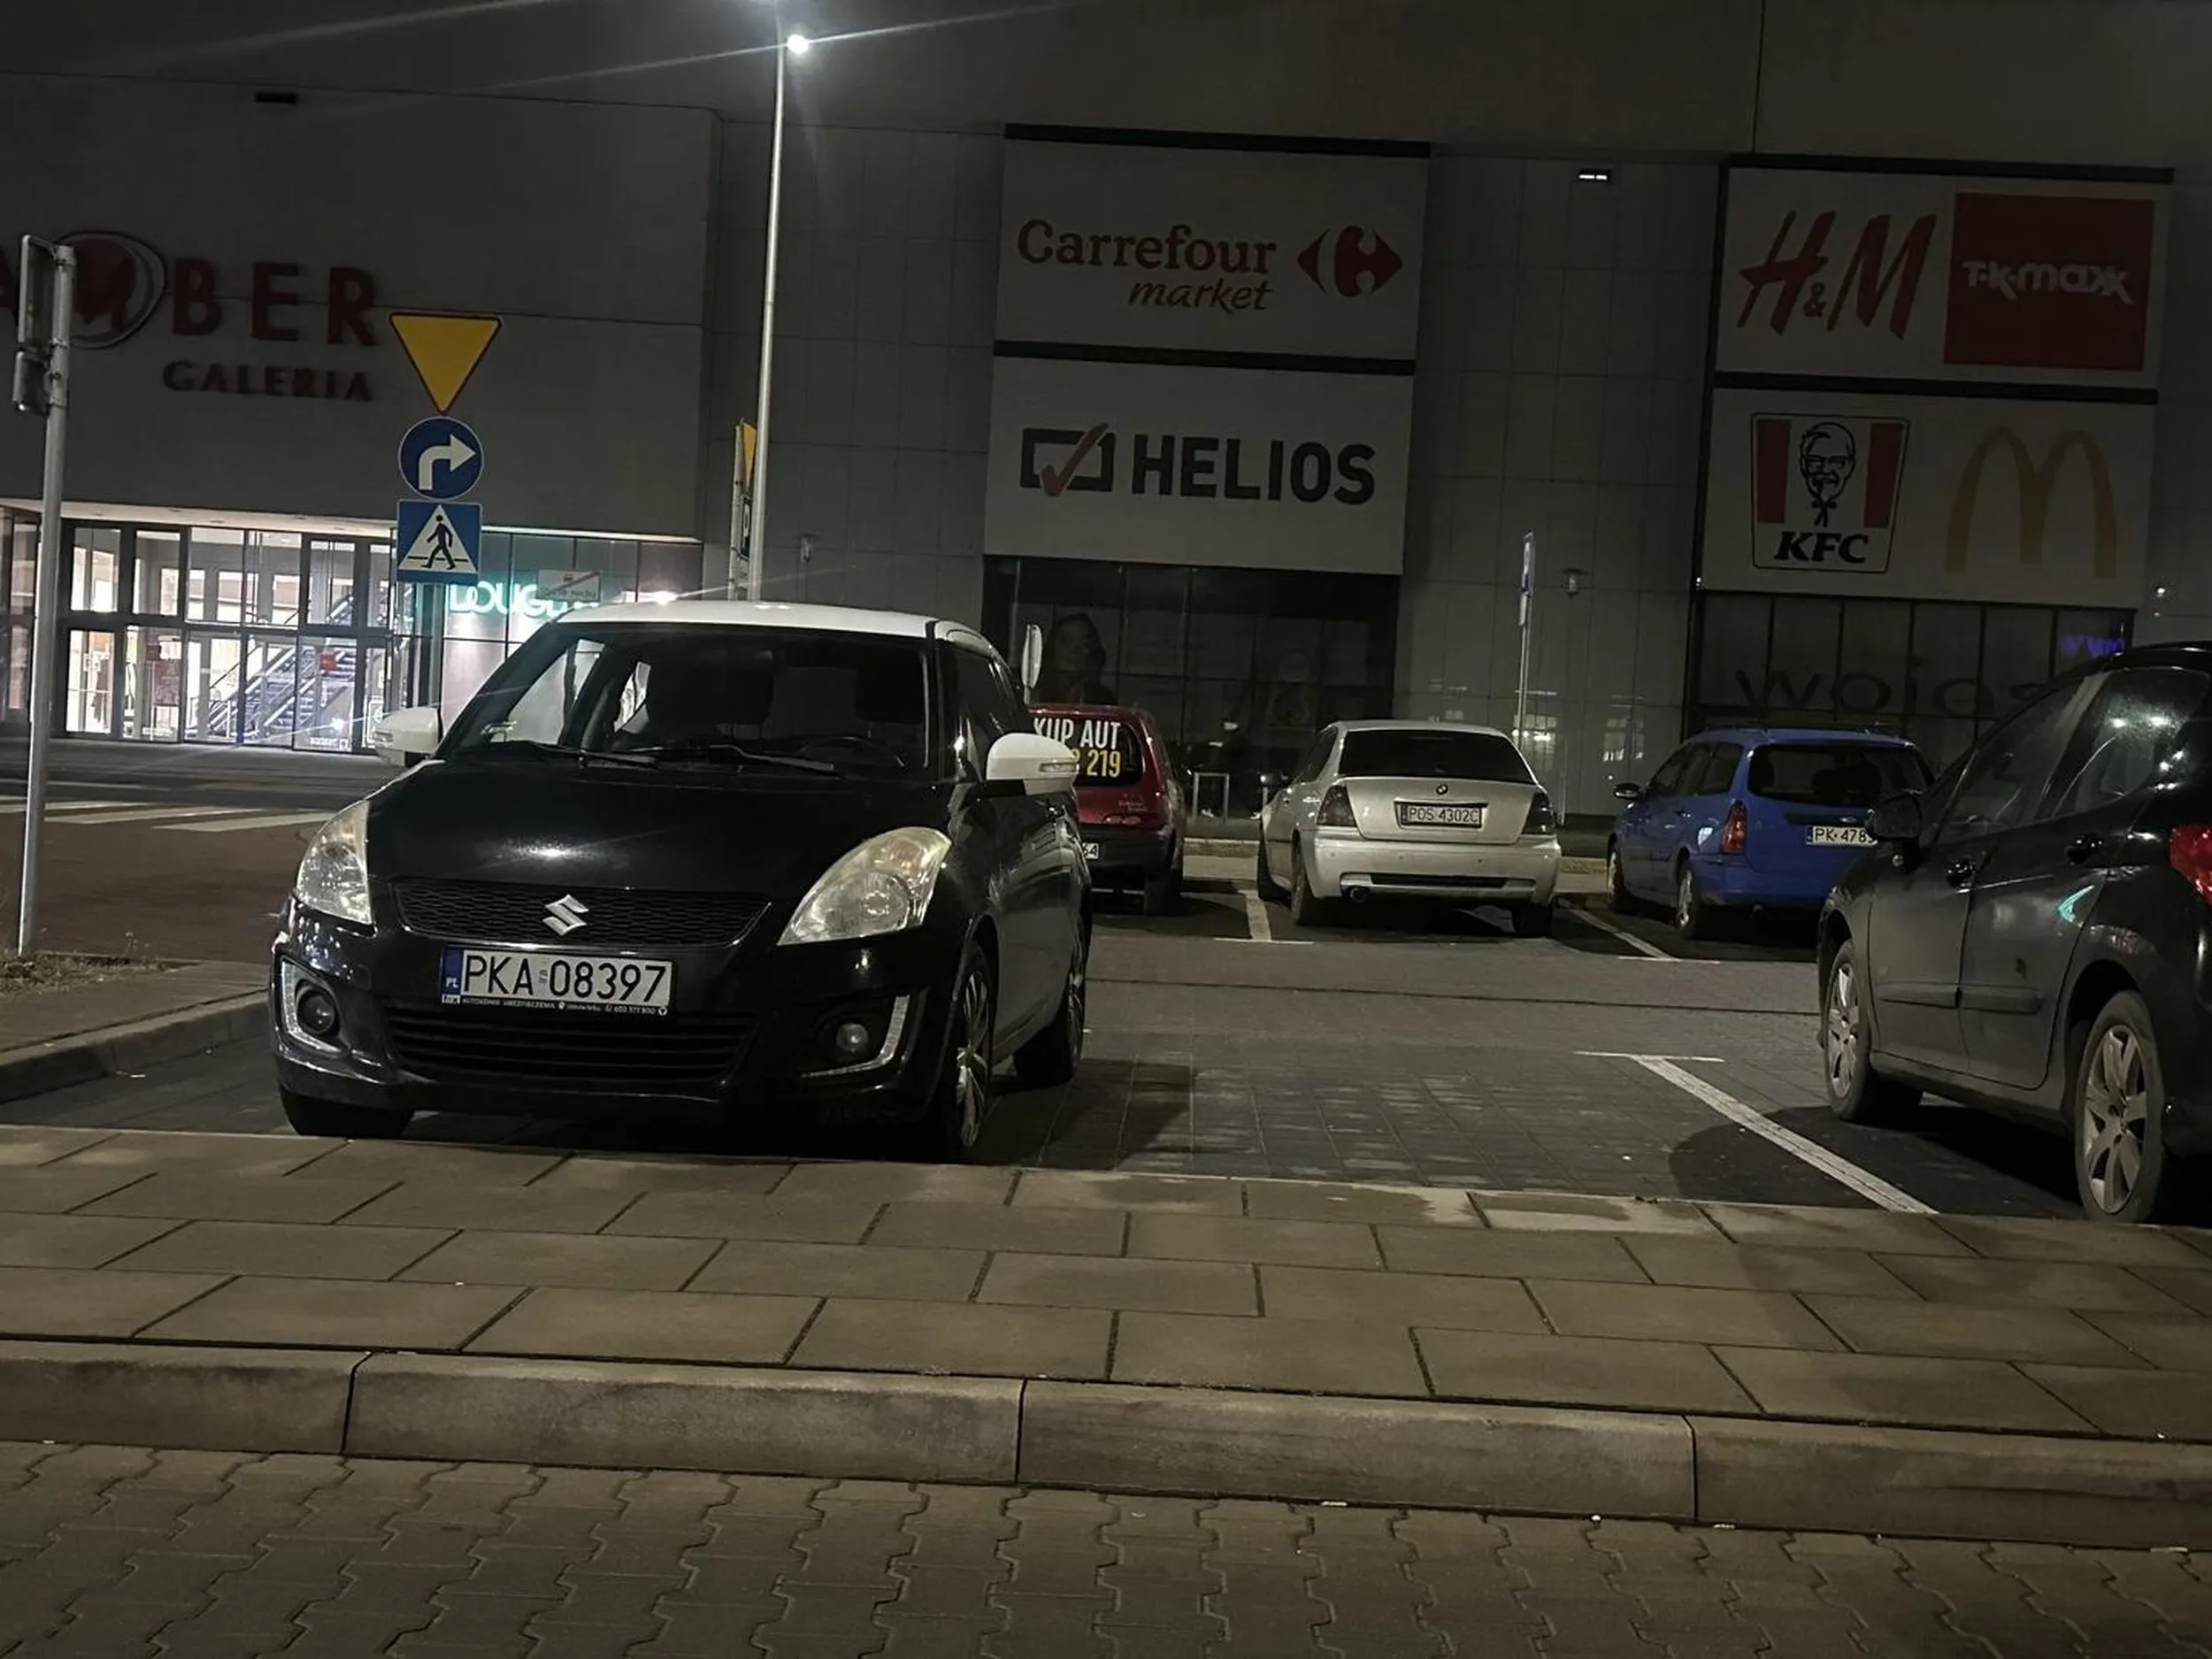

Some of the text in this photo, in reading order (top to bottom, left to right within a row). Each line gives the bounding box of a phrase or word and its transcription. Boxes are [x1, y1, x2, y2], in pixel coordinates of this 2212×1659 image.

[1018, 219, 1277, 274] Carrefour
[1737, 211, 1936, 340] H&M
[1128, 279, 1272, 313] market
[163, 360, 373, 401] GALERIA
[1132, 434, 1376, 505] HELIOS
[1773, 532, 1869, 564] KFC
[1079, 719, 1121, 750] AUT
[1086, 749, 1122, 779] 219
[1409, 806, 1434, 821] POS
[1815, 827, 1834, 841] PK
[465, 954, 666, 1002] PKA 08397
